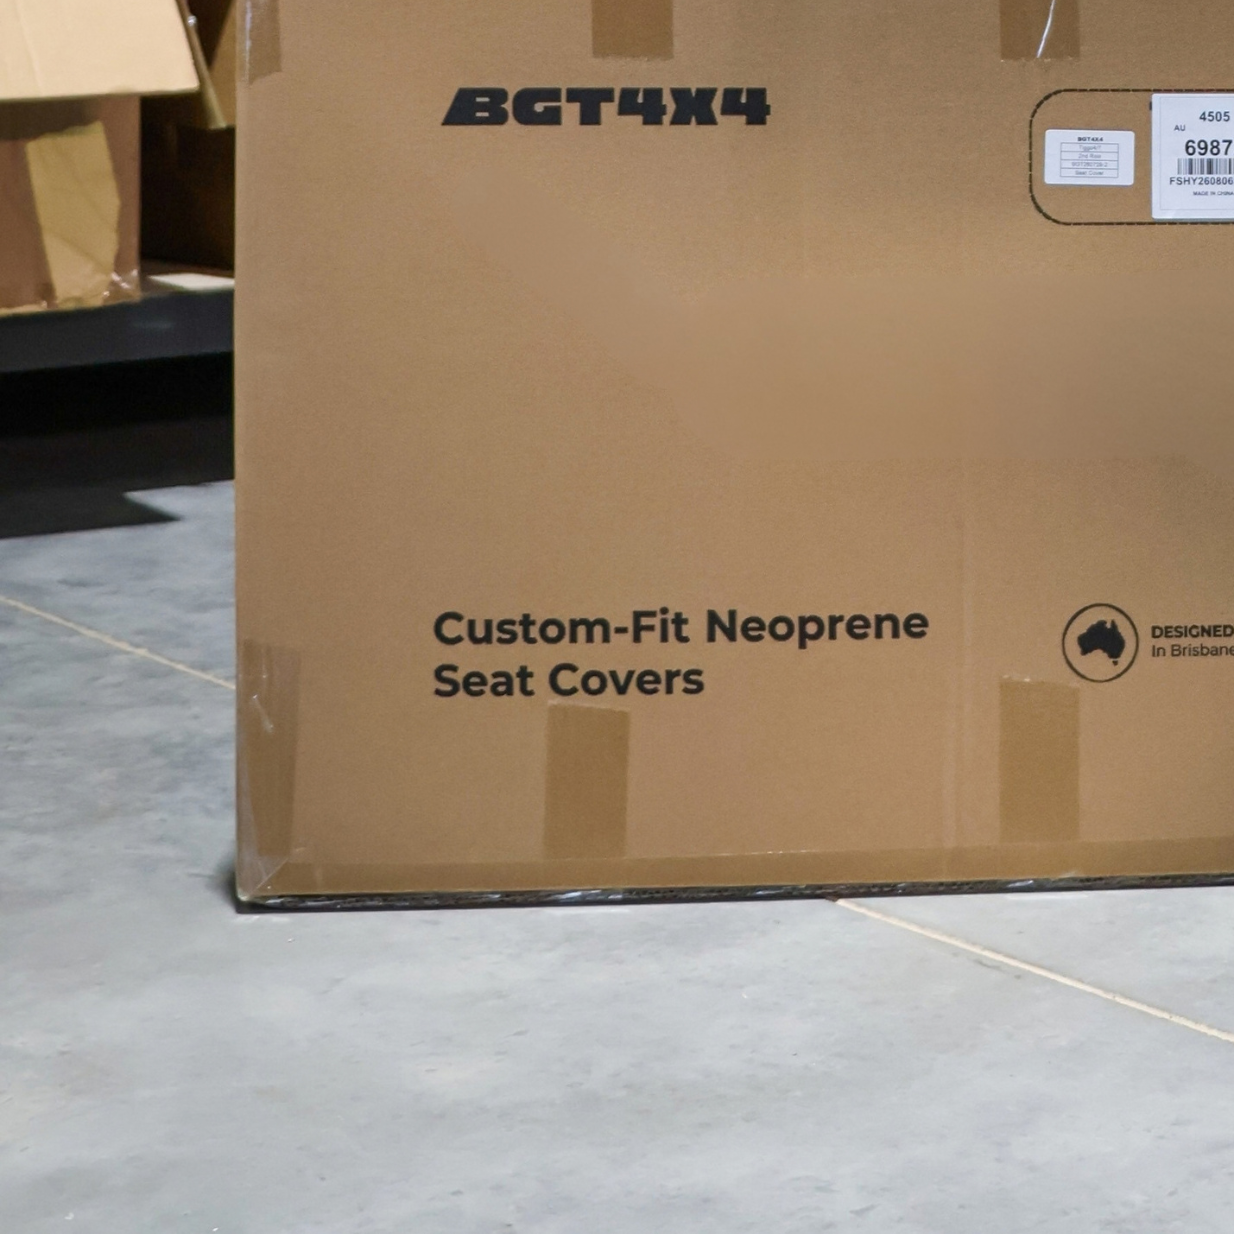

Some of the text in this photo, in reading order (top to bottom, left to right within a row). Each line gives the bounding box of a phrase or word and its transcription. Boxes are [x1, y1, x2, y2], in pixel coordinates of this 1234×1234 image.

[441, 87, 771, 126] BGT4X4
[1199, 111, 1230, 122] 4505
[433, 606, 930, 650] Custom-Fit Neoprene
[1151, 624, 1234, 639] DESIGNED
[1151, 645, 1166, 658] In
[433, 663, 705, 697] Seat Covers
